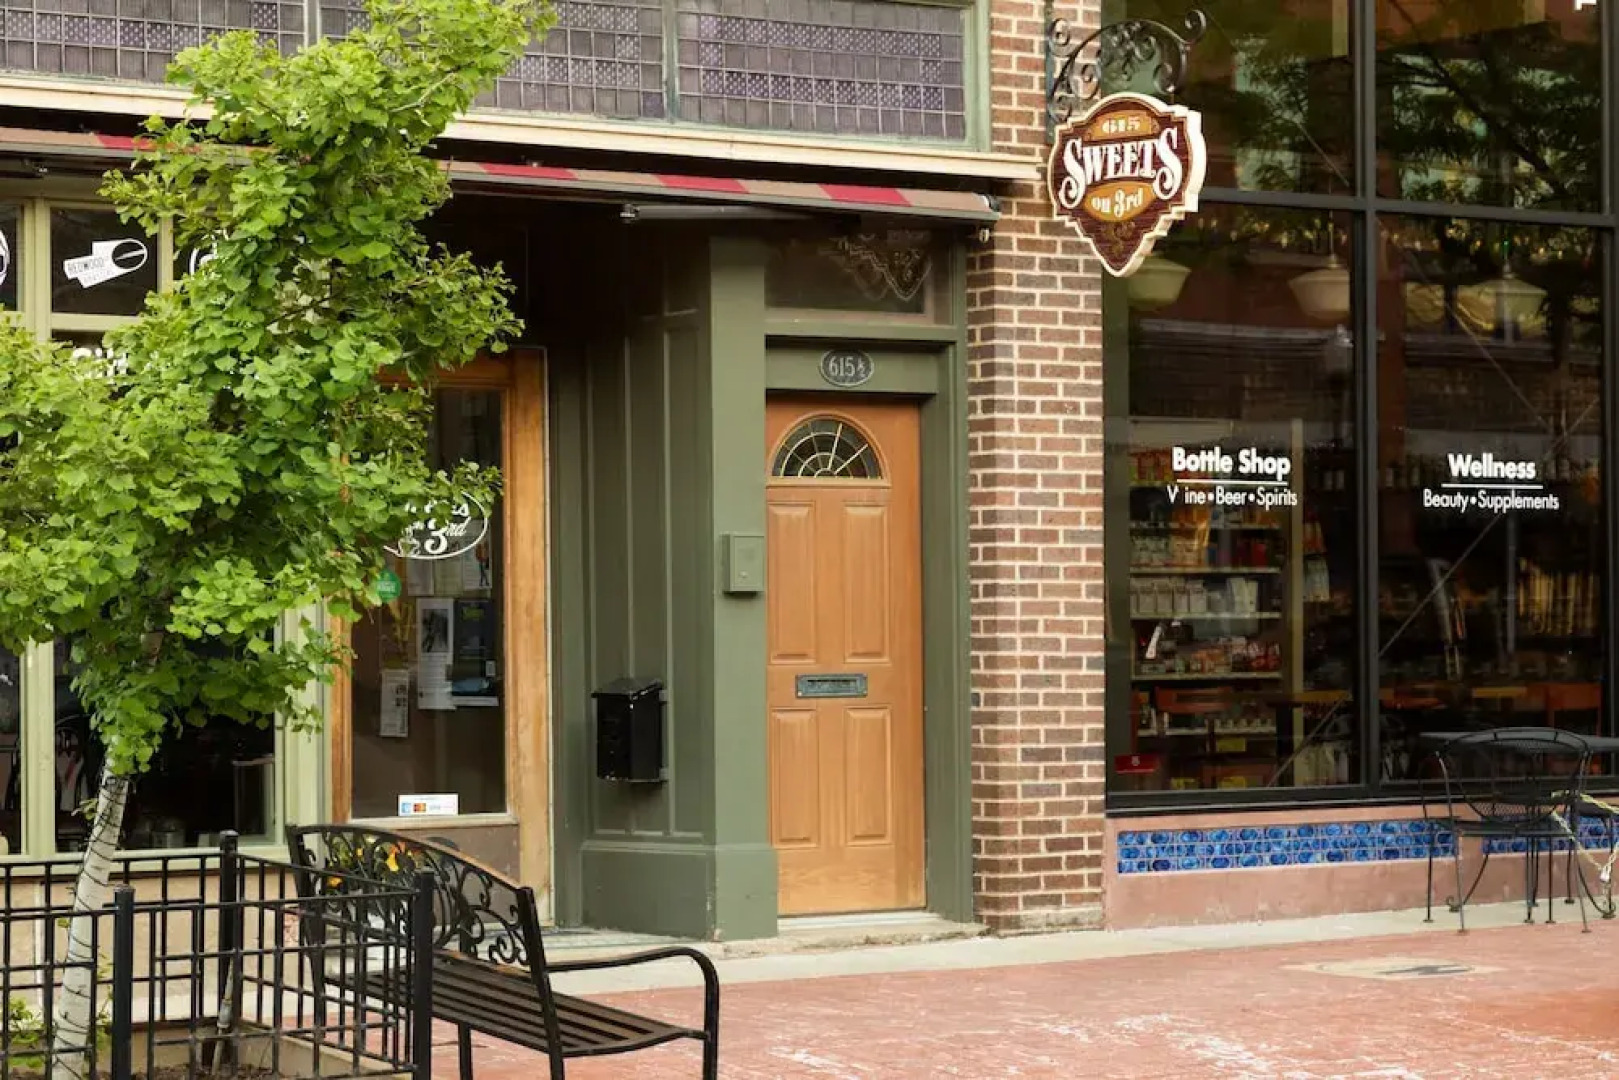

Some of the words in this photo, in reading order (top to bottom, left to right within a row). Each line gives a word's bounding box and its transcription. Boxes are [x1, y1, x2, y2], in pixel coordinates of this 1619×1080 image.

[1102, 116, 1141, 134] 615
[1059, 127, 1184, 208] SWEETS
[1091, 195, 1111, 213] on
[1113, 187, 1144, 218] 3rd
[1172, 446, 1233, 473] Bottle
[1239, 447, 1291, 481] Shop
[1447, 452, 1536, 479] Wellness
[1215, 485, 1247, 505] Beer
[1257, 486, 1297, 511] Spirits
[1423, 488, 1468, 513] Beauty
[1478, 489, 1560, 513] Supplements
